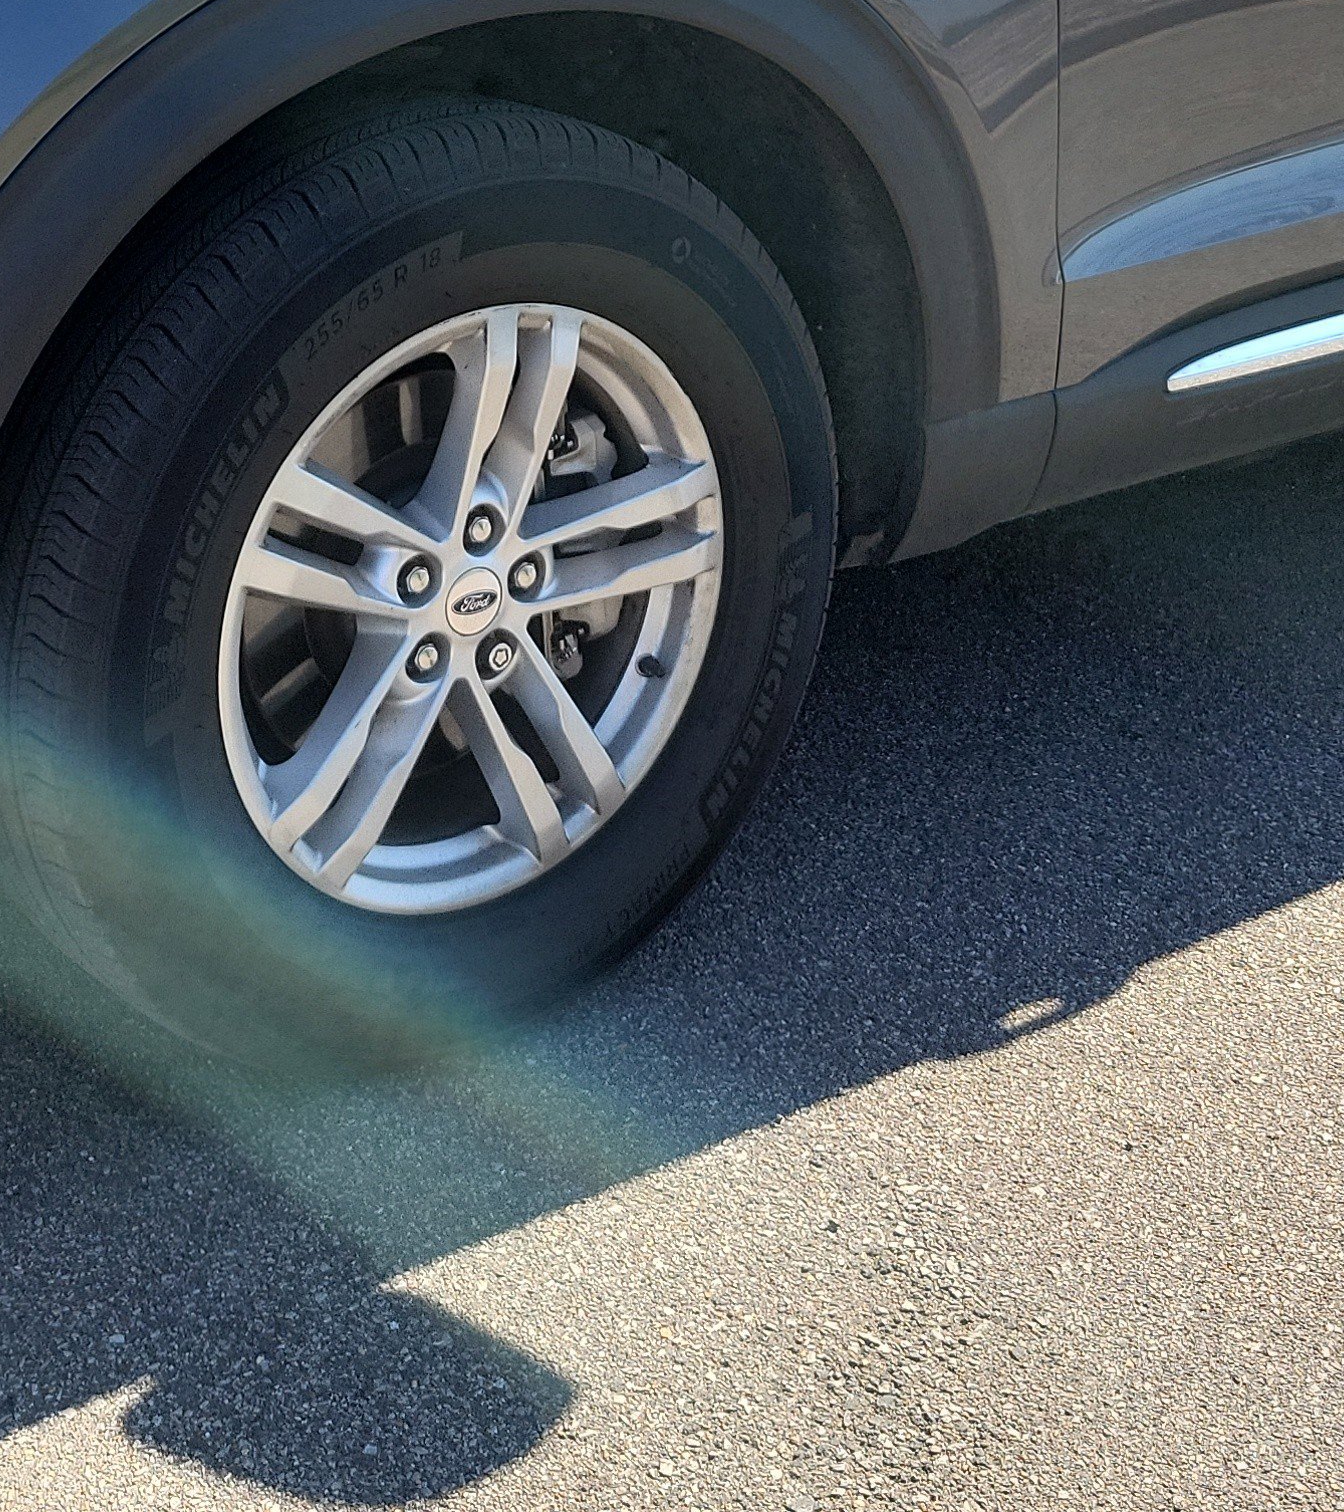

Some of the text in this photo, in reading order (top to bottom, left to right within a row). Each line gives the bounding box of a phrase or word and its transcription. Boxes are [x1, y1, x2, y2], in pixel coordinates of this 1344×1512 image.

[393, 264, 408, 288] R
[420, 246, 442, 273] 18
[164, 382, 281, 625] MICHELIN
[460, 592, 491, 612] Ford
[704, 611, 799, 821] MICHELIN
